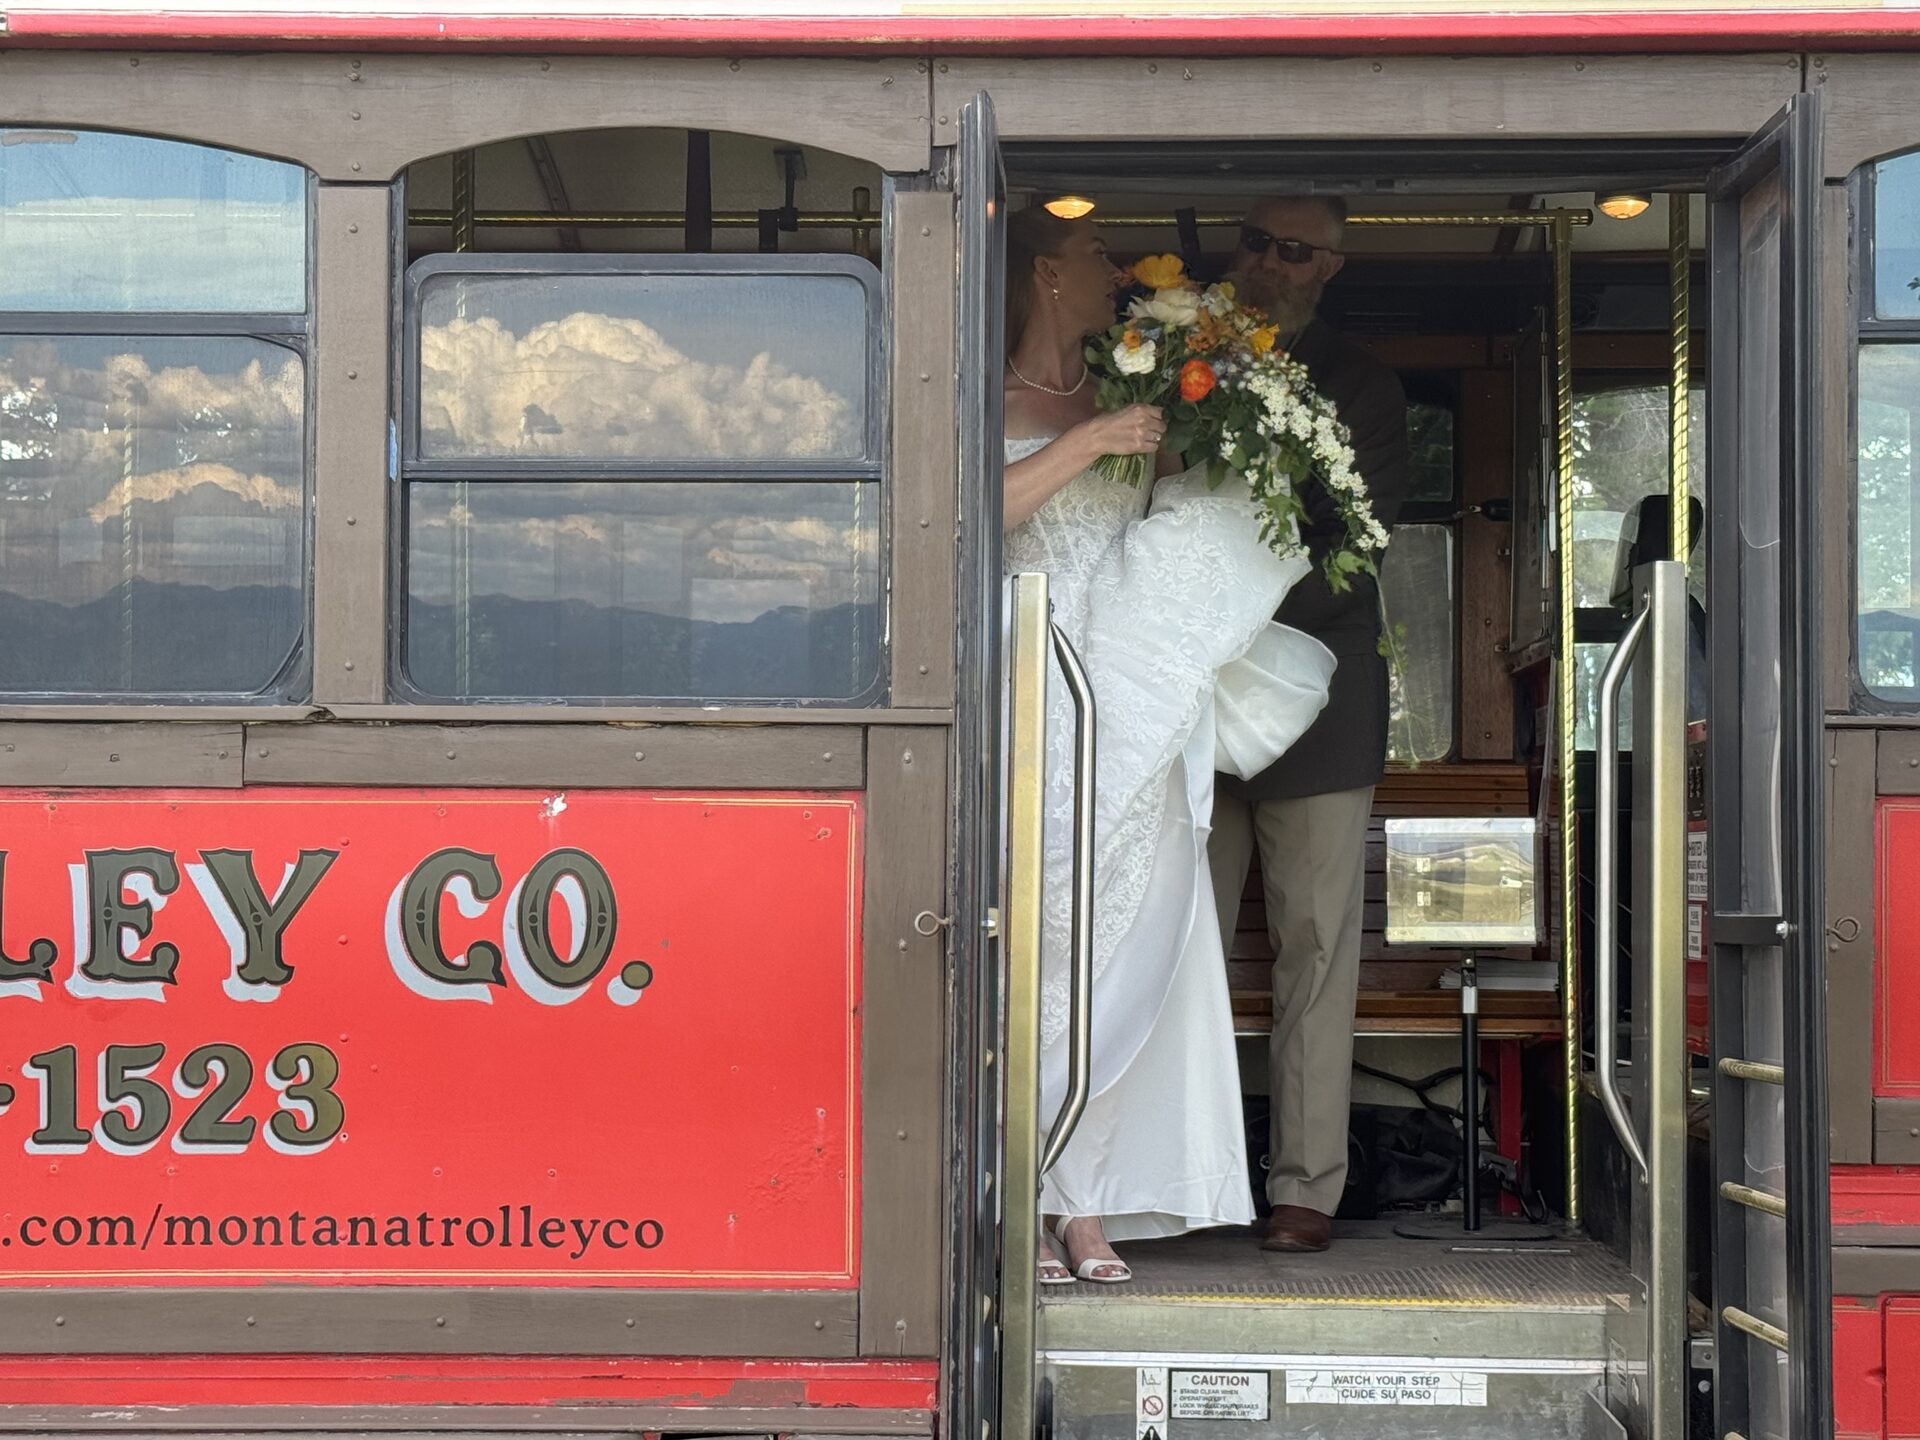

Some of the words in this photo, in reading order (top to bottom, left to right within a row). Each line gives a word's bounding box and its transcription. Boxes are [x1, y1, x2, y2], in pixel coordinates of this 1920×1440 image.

[384, 846, 653, 1006] CO.
[2, 1204, 665, 1259] .com/montanatrolleyco
[1191, 1375, 1250, 1386] CAUTION
[1333, 1375, 1371, 1385] WATCH
[1375, 1376, 1406, 1385] YOUR
[1411, 1376, 1440, 1386] STEP
[1380, 1389, 1397, 1399] SU
[1401, 1389, 1431, 1399] PASO
